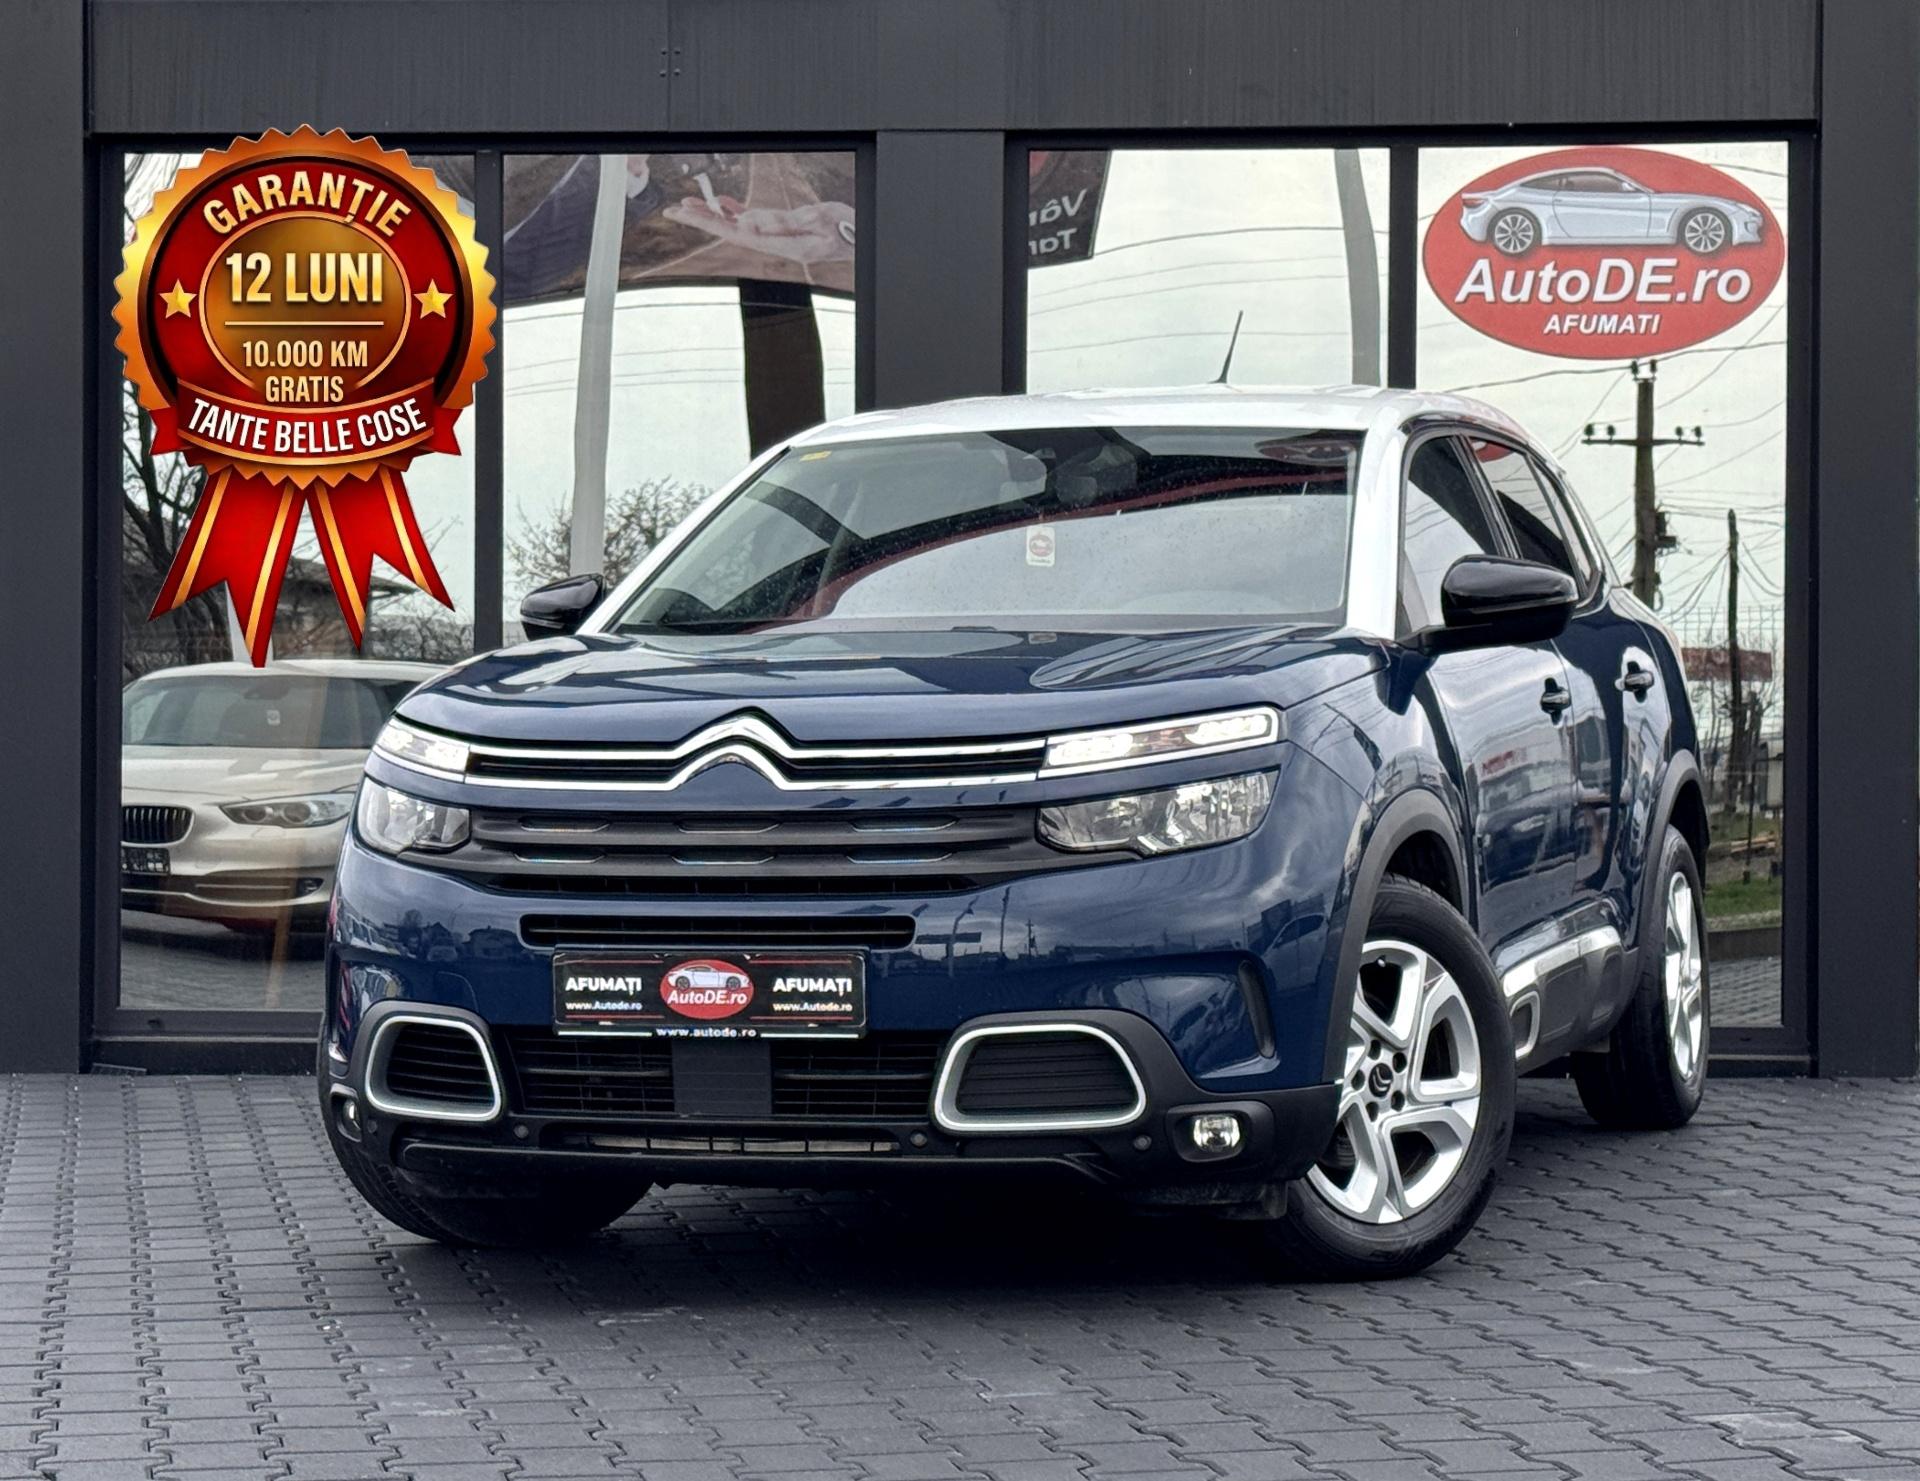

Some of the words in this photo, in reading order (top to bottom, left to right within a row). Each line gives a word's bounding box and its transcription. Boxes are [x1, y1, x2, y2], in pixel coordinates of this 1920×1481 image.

[1454, 258, 1751, 304] AutoDE.ro
[1543, 314, 1662, 335] AFUMATI
[667, 989, 748, 1005] AutoDE.ro
[565, 1001, 643, 1011] www.Autode.ro
[772, 1002, 853, 1012] www.Autode.ro
[656, 1027, 757, 1038] www.autode.ro
